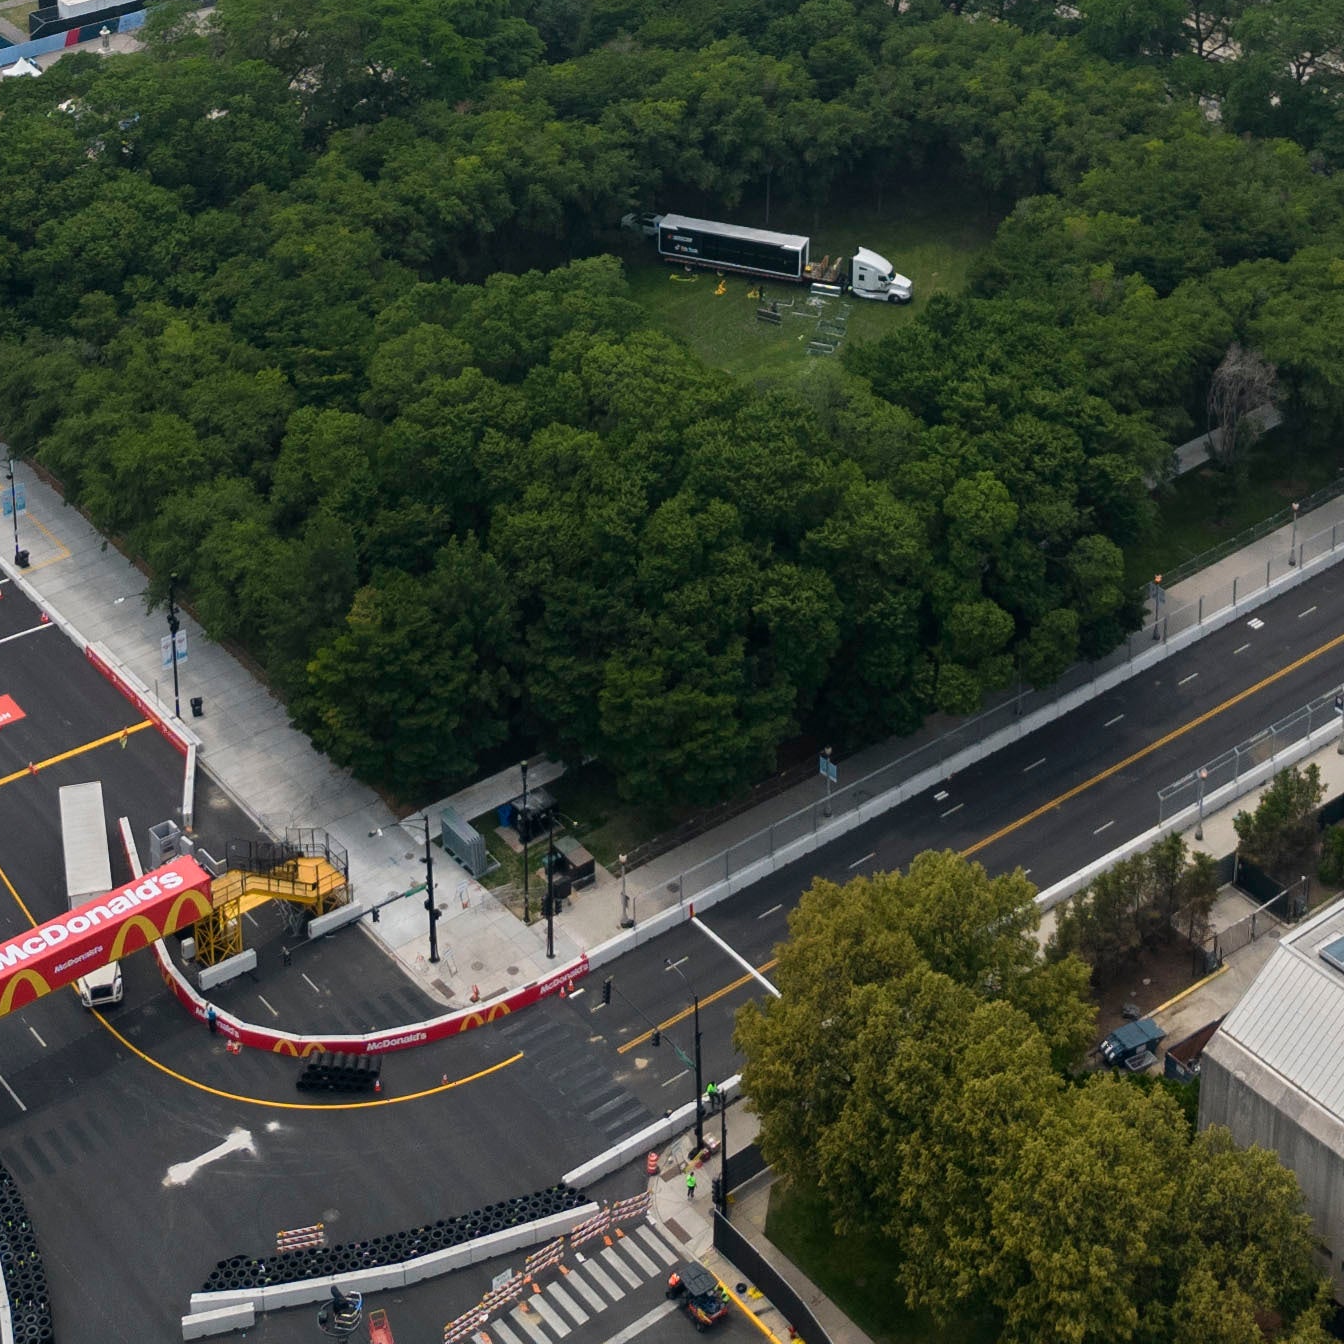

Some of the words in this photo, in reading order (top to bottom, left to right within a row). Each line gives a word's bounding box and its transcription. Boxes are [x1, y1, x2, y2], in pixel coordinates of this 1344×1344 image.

[54, 944, 104, 974] McDonald's
[540, 964, 589, 995] McDonald's
[367, 1030, 427, 1052] McDonald's
